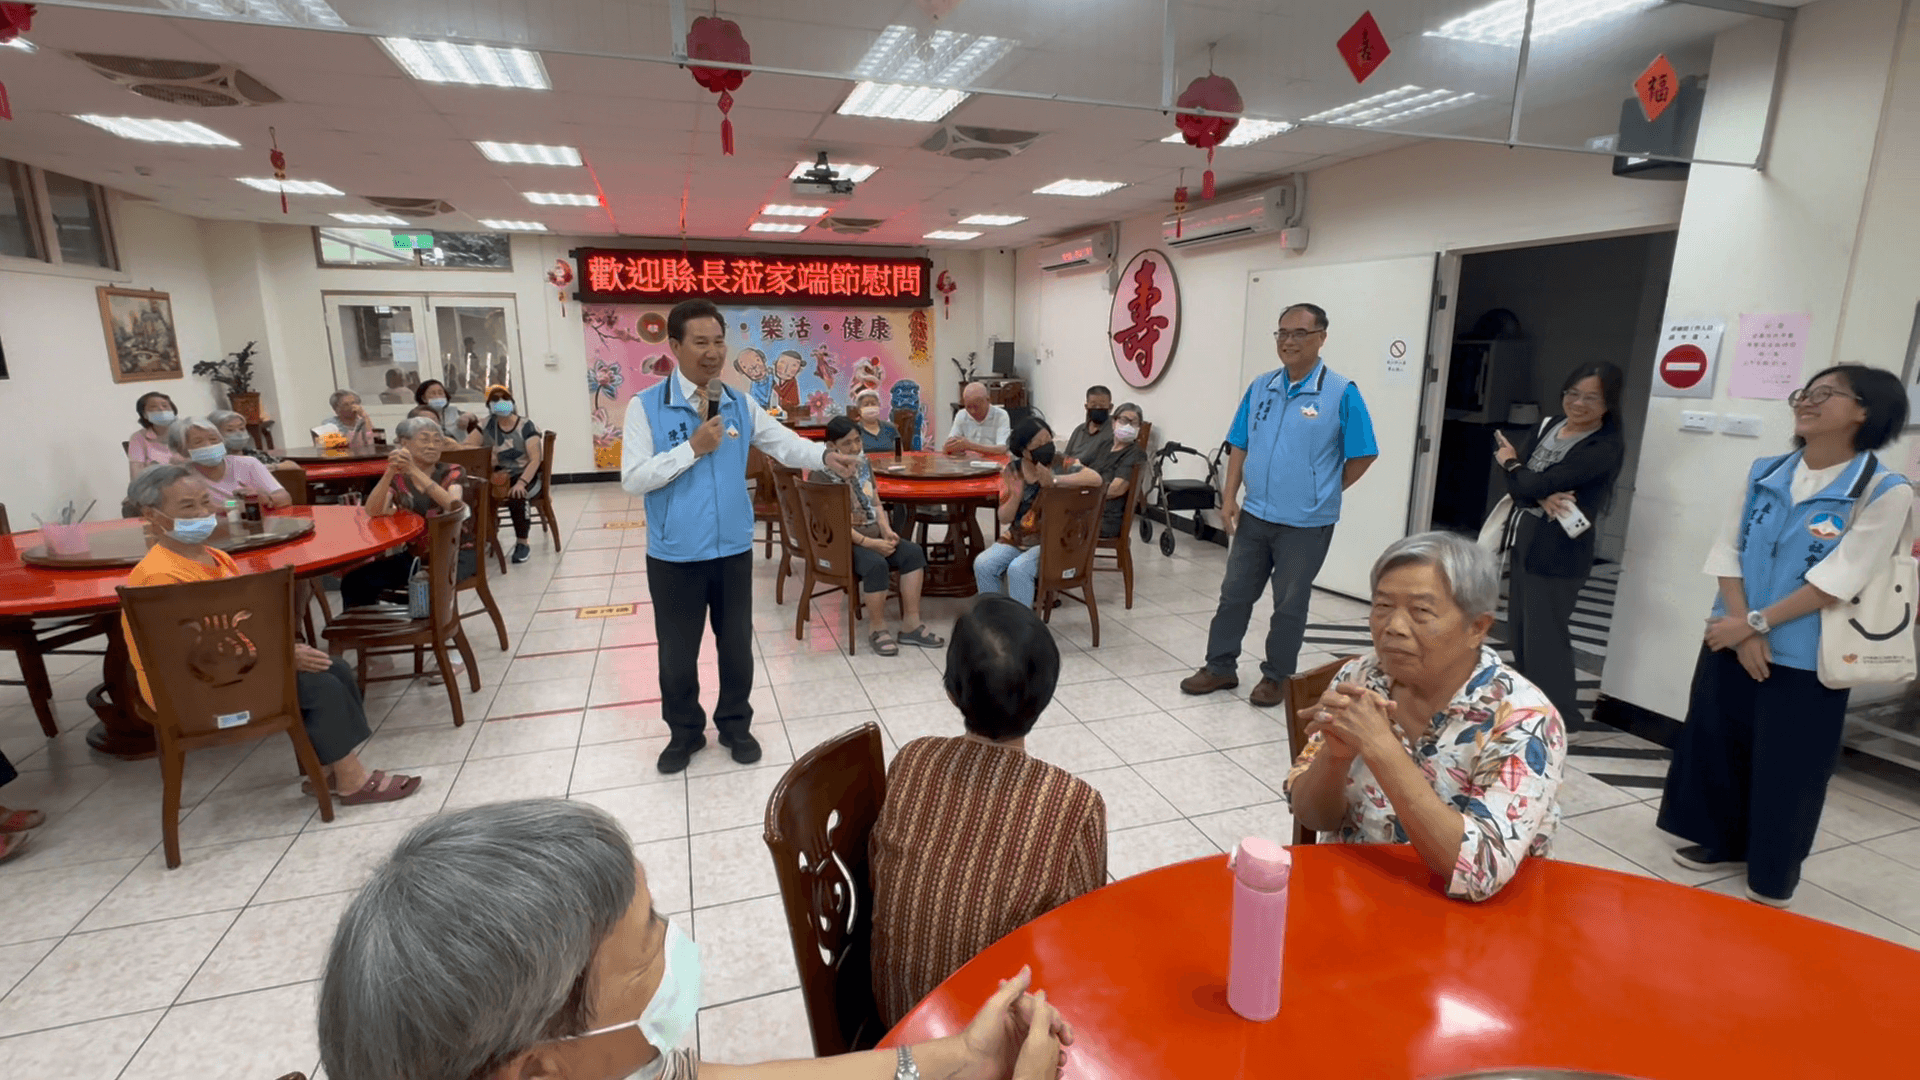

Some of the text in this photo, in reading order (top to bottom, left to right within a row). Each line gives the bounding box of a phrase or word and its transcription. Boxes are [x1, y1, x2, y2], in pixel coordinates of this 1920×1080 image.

[1648, 74, 1669, 103] 福
[588, 256, 921, 297] 歡迎縣長蒞家端節慰問
[1113, 259, 1169, 378] 壽
